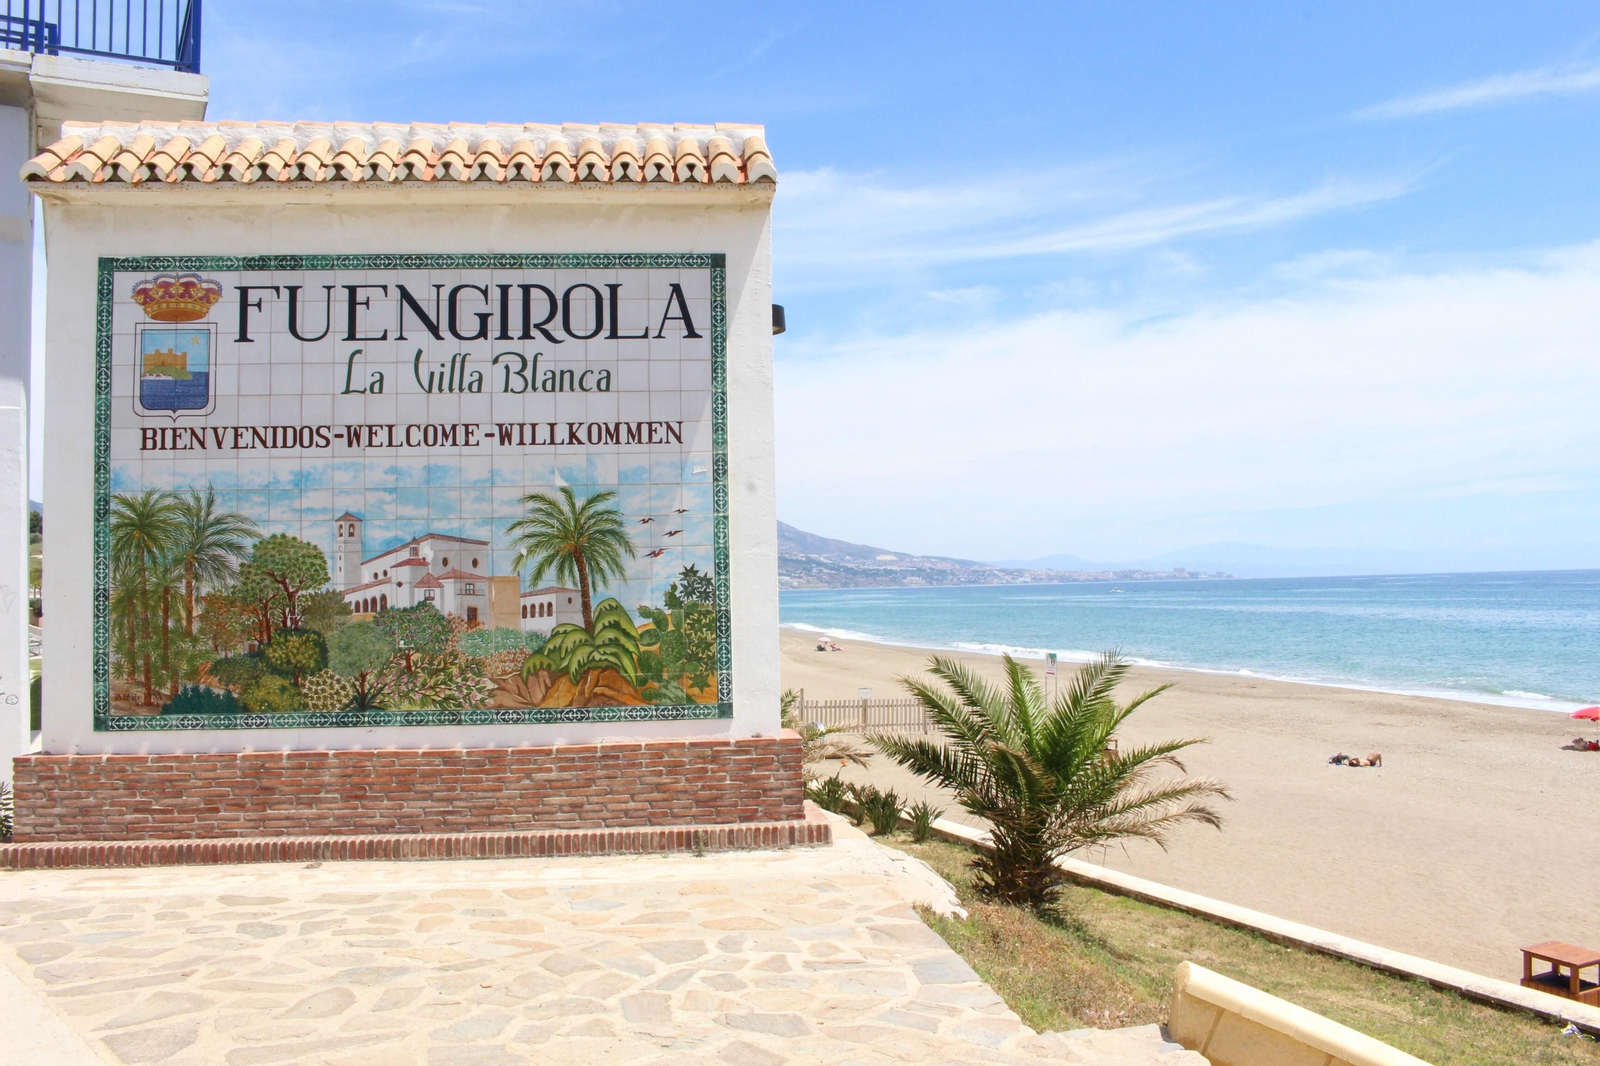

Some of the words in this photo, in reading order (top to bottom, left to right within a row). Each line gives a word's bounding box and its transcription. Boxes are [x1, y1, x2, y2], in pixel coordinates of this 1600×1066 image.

[233, 282, 703, 344] FUENGIROLA
[341, 348, 385, 395] La
[413, 347, 484, 394] Villa
[492, 351, 612, 394] Blanca
